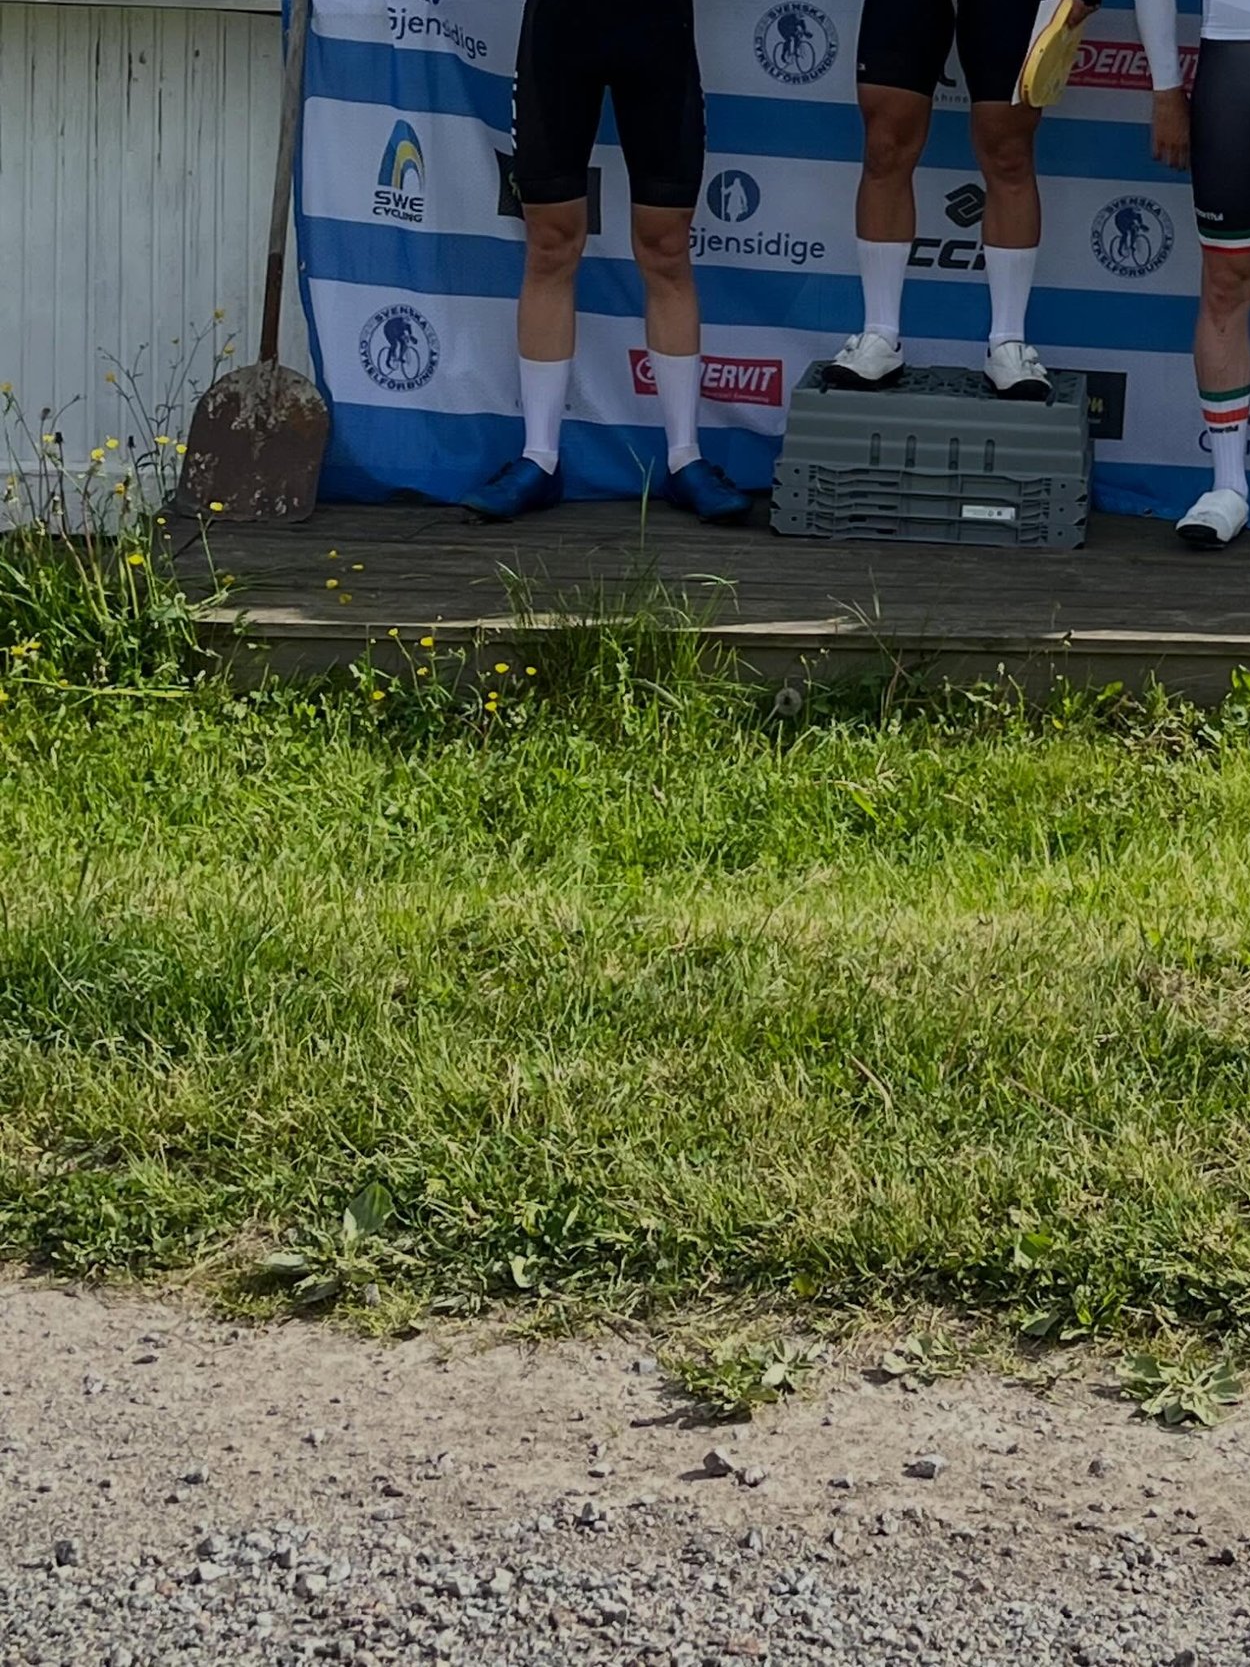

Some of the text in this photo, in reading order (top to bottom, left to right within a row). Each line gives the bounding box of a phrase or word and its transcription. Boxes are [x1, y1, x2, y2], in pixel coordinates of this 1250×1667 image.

[767, 3, 826, 23] SVENSKA
[934, 93, 969, 103] shine
[374, 191, 424, 213] SWE
[1104, 197, 1162, 216] SVENSKA
[372, 206, 423, 223] CYCLING
[374, 306, 427, 331] SVENSKA
